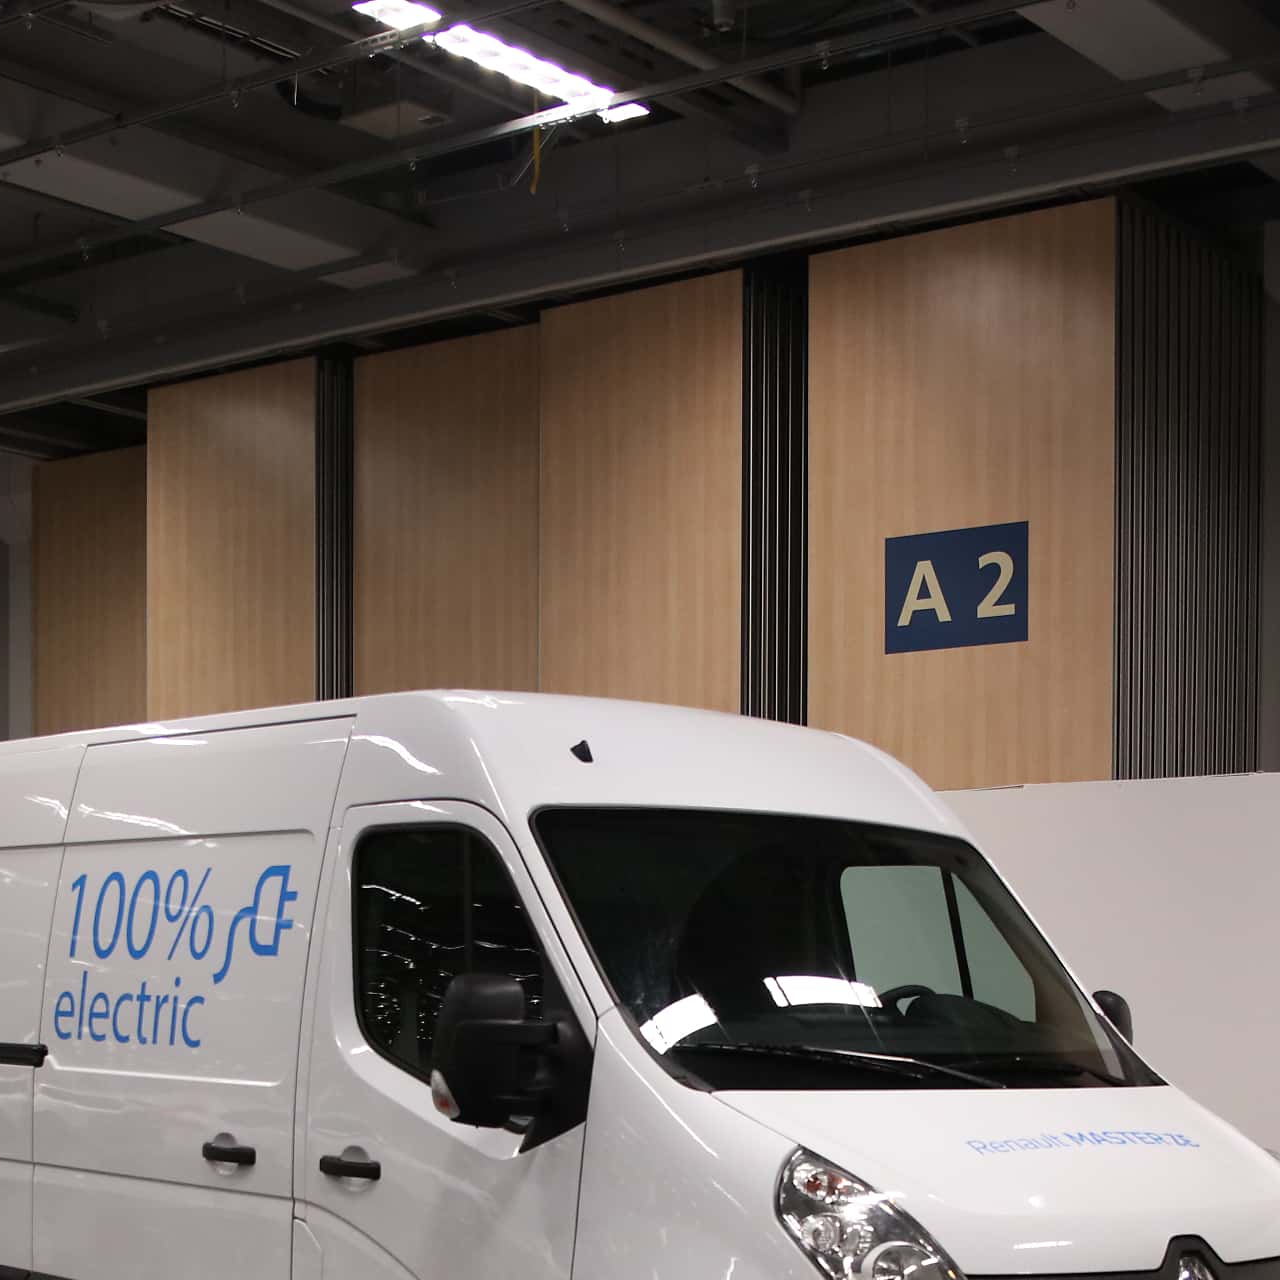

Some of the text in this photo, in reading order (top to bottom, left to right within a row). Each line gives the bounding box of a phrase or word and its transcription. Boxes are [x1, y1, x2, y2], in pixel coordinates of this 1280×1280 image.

[897, 551, 1015, 626] A 2
[70, 867, 214, 960] 100%
[54, 970, 205, 1048] electric
[966, 1132, 1068, 1155] Renault
[1064, 1131, 1166, 1145] MASTER
